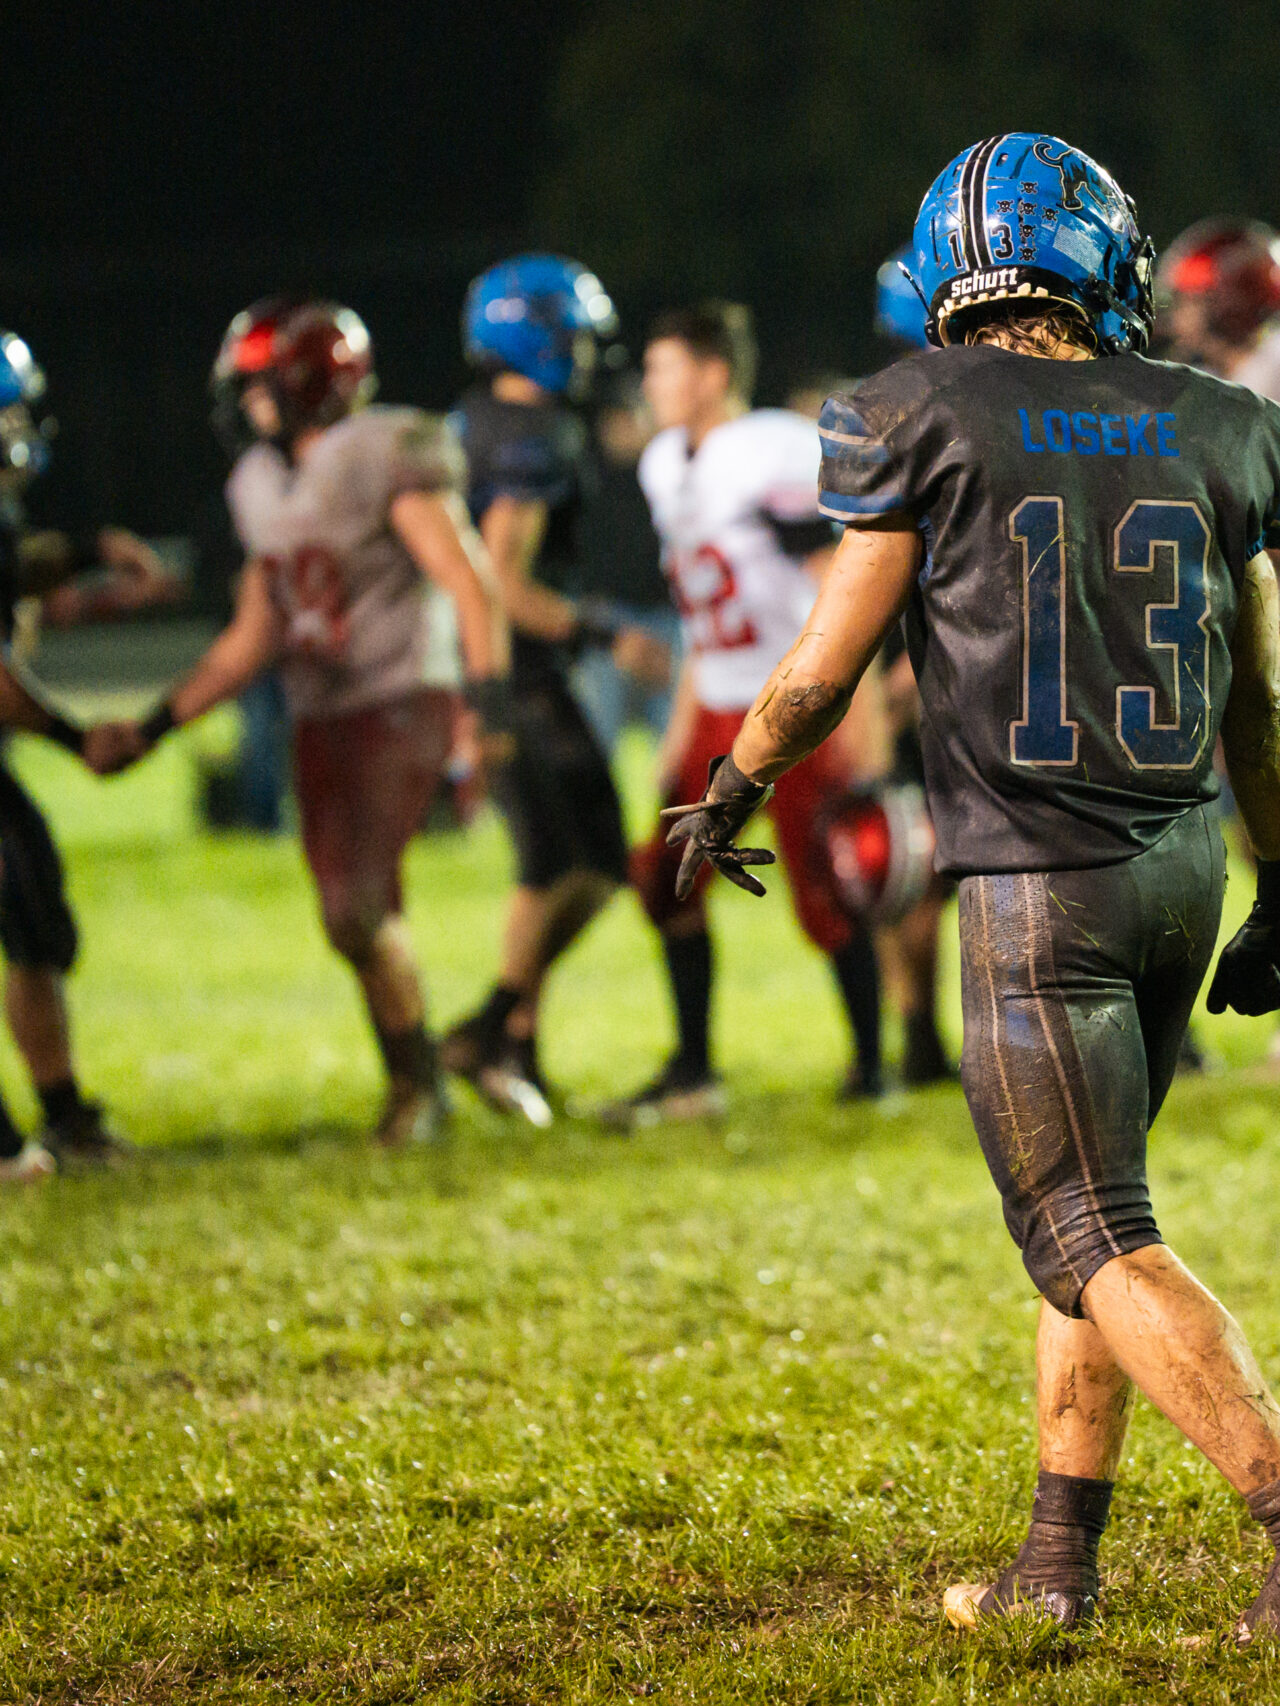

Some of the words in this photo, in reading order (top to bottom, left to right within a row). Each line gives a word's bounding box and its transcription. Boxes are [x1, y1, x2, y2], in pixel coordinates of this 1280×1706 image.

[950, 267, 1018, 298] schutt
[1017, 408, 1180, 457] LOSEKE
[1008, 495, 1213, 771] 13
